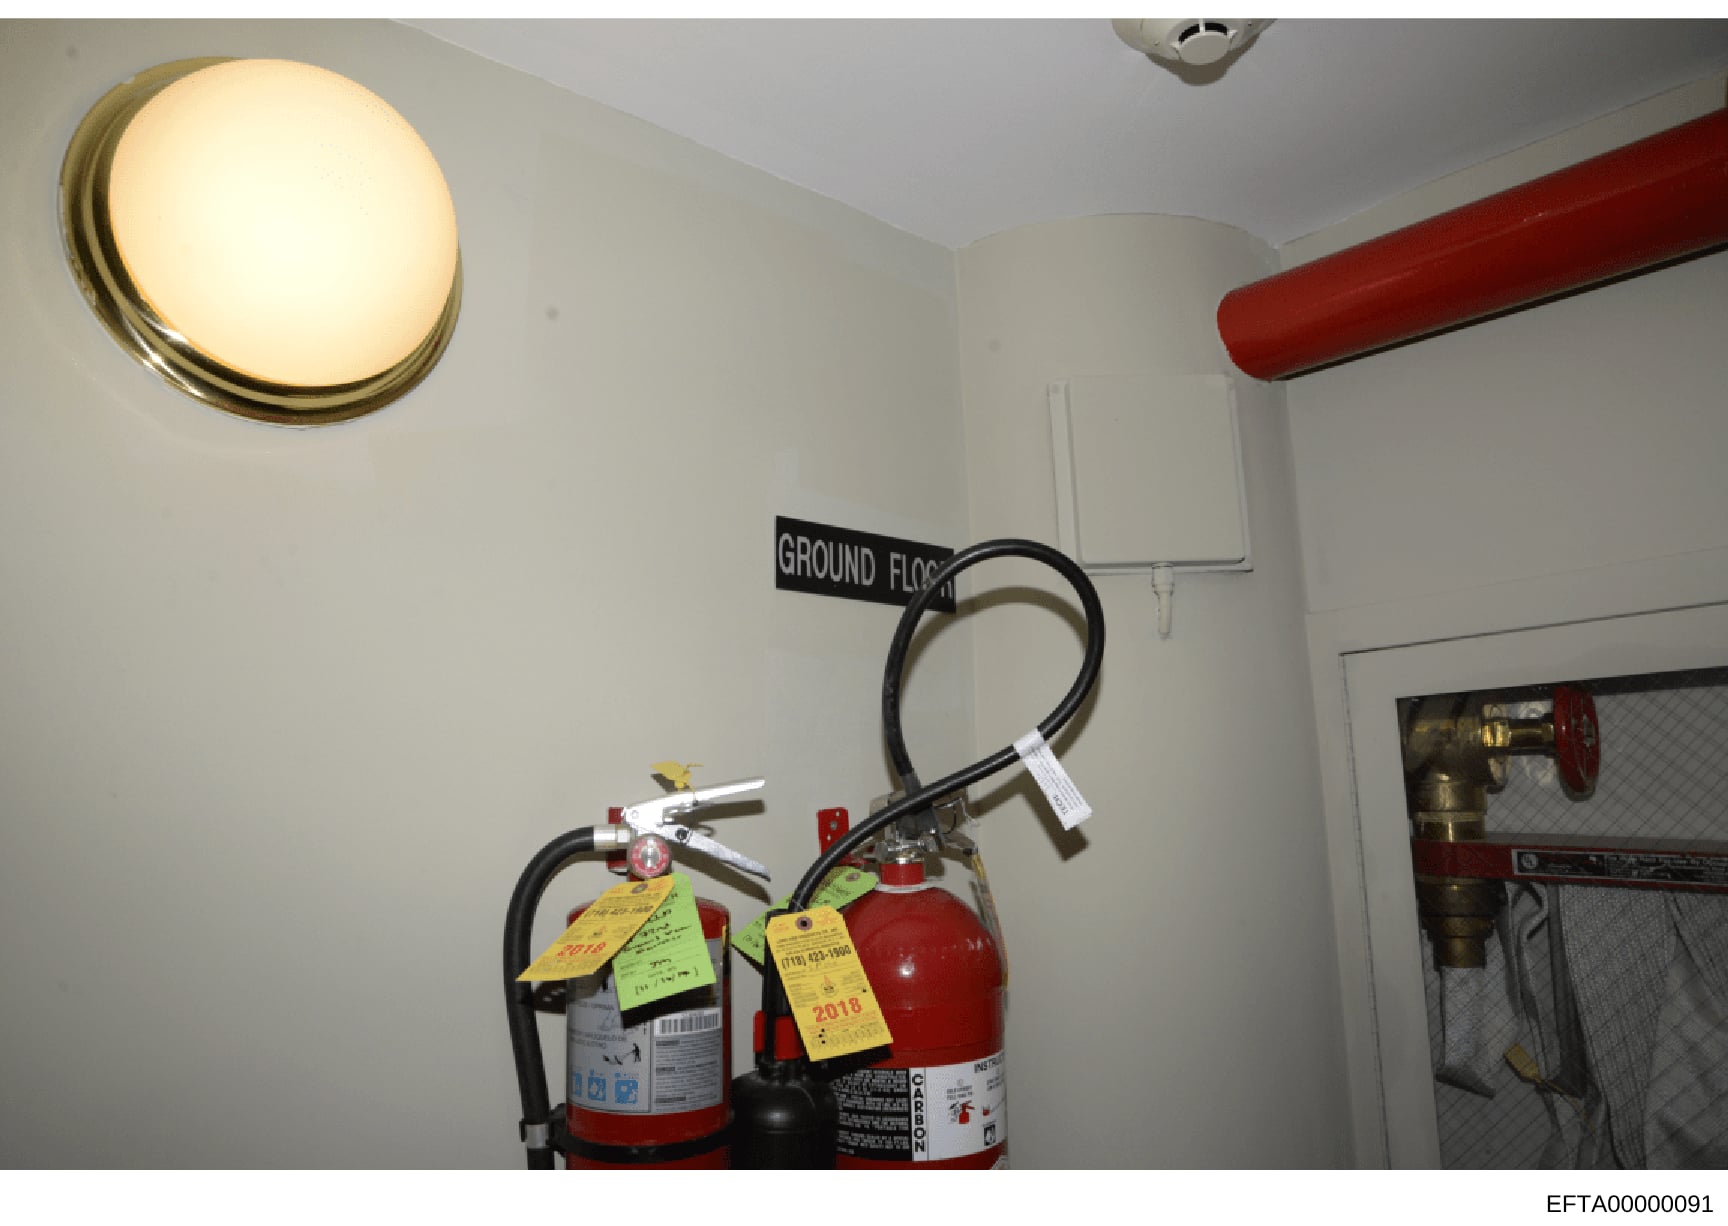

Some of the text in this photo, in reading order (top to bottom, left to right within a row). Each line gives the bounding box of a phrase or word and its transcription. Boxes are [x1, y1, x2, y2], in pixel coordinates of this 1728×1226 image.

[778, 533, 876, 586] GROUND
[557, 942, 607, 957] 2018
[781, 944, 852, 970] (718) 423-1900
[813, 997, 862, 1023] 2018
[911, 1073, 927, 1153] CARBON
